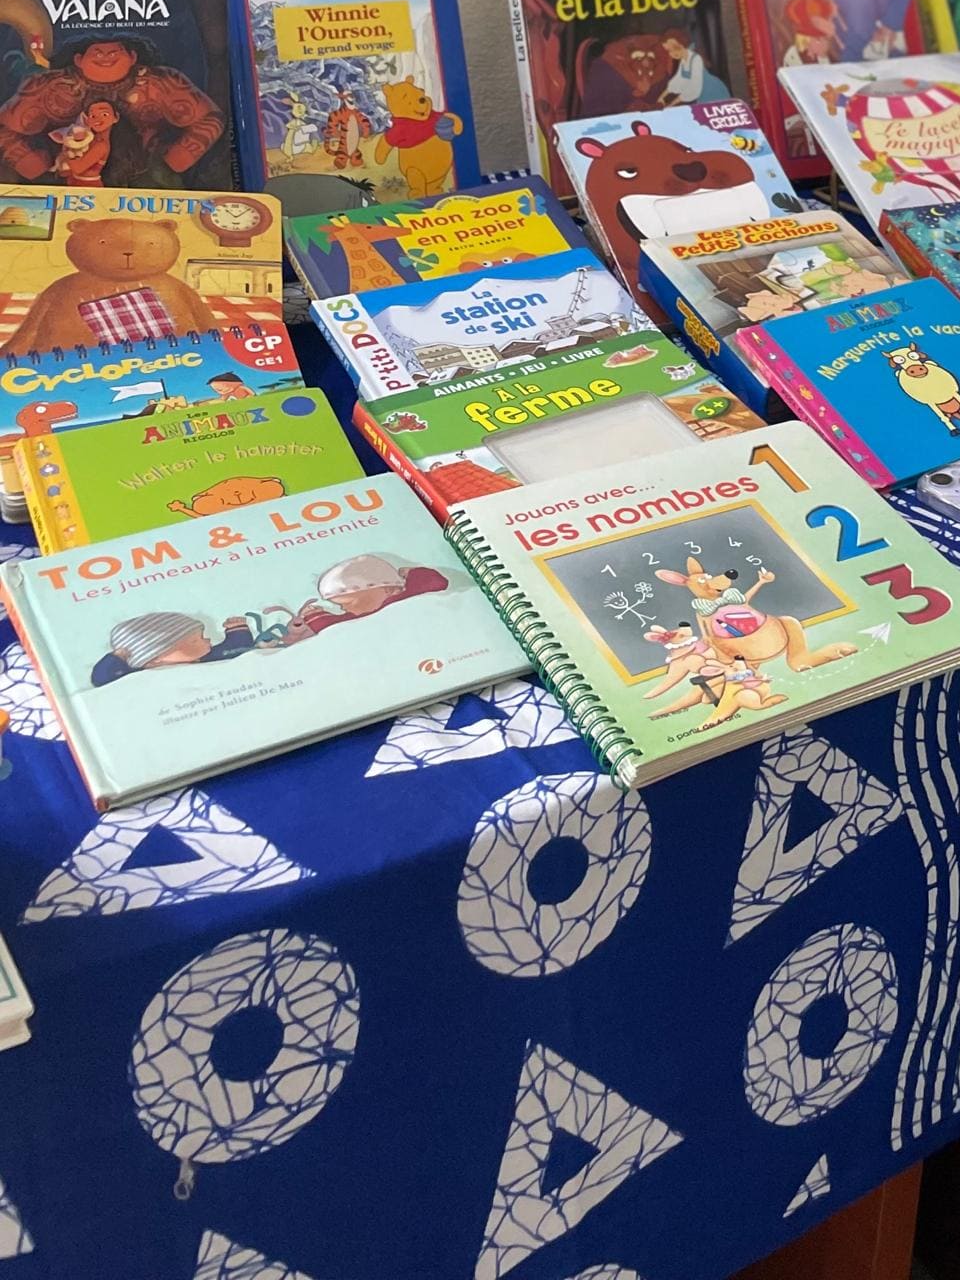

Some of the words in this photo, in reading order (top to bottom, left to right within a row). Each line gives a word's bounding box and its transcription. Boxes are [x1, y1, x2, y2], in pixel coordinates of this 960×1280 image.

[304, 4, 380, 24] Winnie
[298, 24, 393, 43] l'Ourson,
[303, 45, 313, 55] le
[317, 42, 351, 57] grand
[355, 40, 395, 53] voyage
[703, 103, 746, 118] LIVRE
[43, 193, 96, 211] LES
[110, 194, 216, 215] JOUETS
[409, 213, 464, 230] Mon
[471, 204, 512, 219] zoo
[417, 233, 447, 246] en
[454, 217, 525, 242] papier
[671, 238, 740, 258] Petits
[743, 222, 836, 246] Cochons
[697, 230, 735, 242] Les
[737, 219, 797, 235] Trois
[441, 291, 548, 325] station
[471, 290, 492, 300] La
[327, 299, 379, 350] DOCS
[464, 324, 487, 335] de
[490, 311, 537, 334] ski
[825, 297, 914, 333] ANIMAUX
[244, 335, 283, 353] CP
[255, 355, 284, 367] CE1
[816, 331, 900, 381] Marguerite
[902, 324, 924, 338] la
[370, 348, 411, 391] P'tits
[433, 373, 505, 397] AIMANTS
[520, 362, 546, 376] JEU
[562, 347, 604, 365] LIVRE
[464, 379, 622, 432] ferme
[494, 387, 515, 403] À
[516, 382, 542, 396] la
[697, 401, 724, 416] 3+
[142, 408, 270, 445] ANIMAUX
[183, 430, 235, 444] RIGOLOS
[119, 457, 198, 490] Walter
[204, 449, 228, 464] le
[234, 441, 323, 459] hamster
[749, 443, 811, 493] 1
[504, 498, 580, 526] Jouons
[583, 483, 656, 505] avec...
[514, 522, 580, 551] les
[586, 476, 760, 533] nombres
[38, 540, 181, 590] TOM
[207, 526, 248, 549] &
[269, 489, 385, 533] LOU
[805, 505, 891, 562] 2
[71, 586, 112, 603] Les
[118, 556, 221, 594] jumeaux
[228, 550, 241, 561] à
[247, 544, 267, 556] la
[273, 514, 381, 549] maternité
[600, 564, 617, 577] 1
[642, 552, 660, 566] 2
[683, 541, 702, 555] 3
[728, 536, 743, 548] 4
[745, 554, 762, 566] 5
[860, 563, 953, 625] 3
[278, 679, 304, 691] Man
